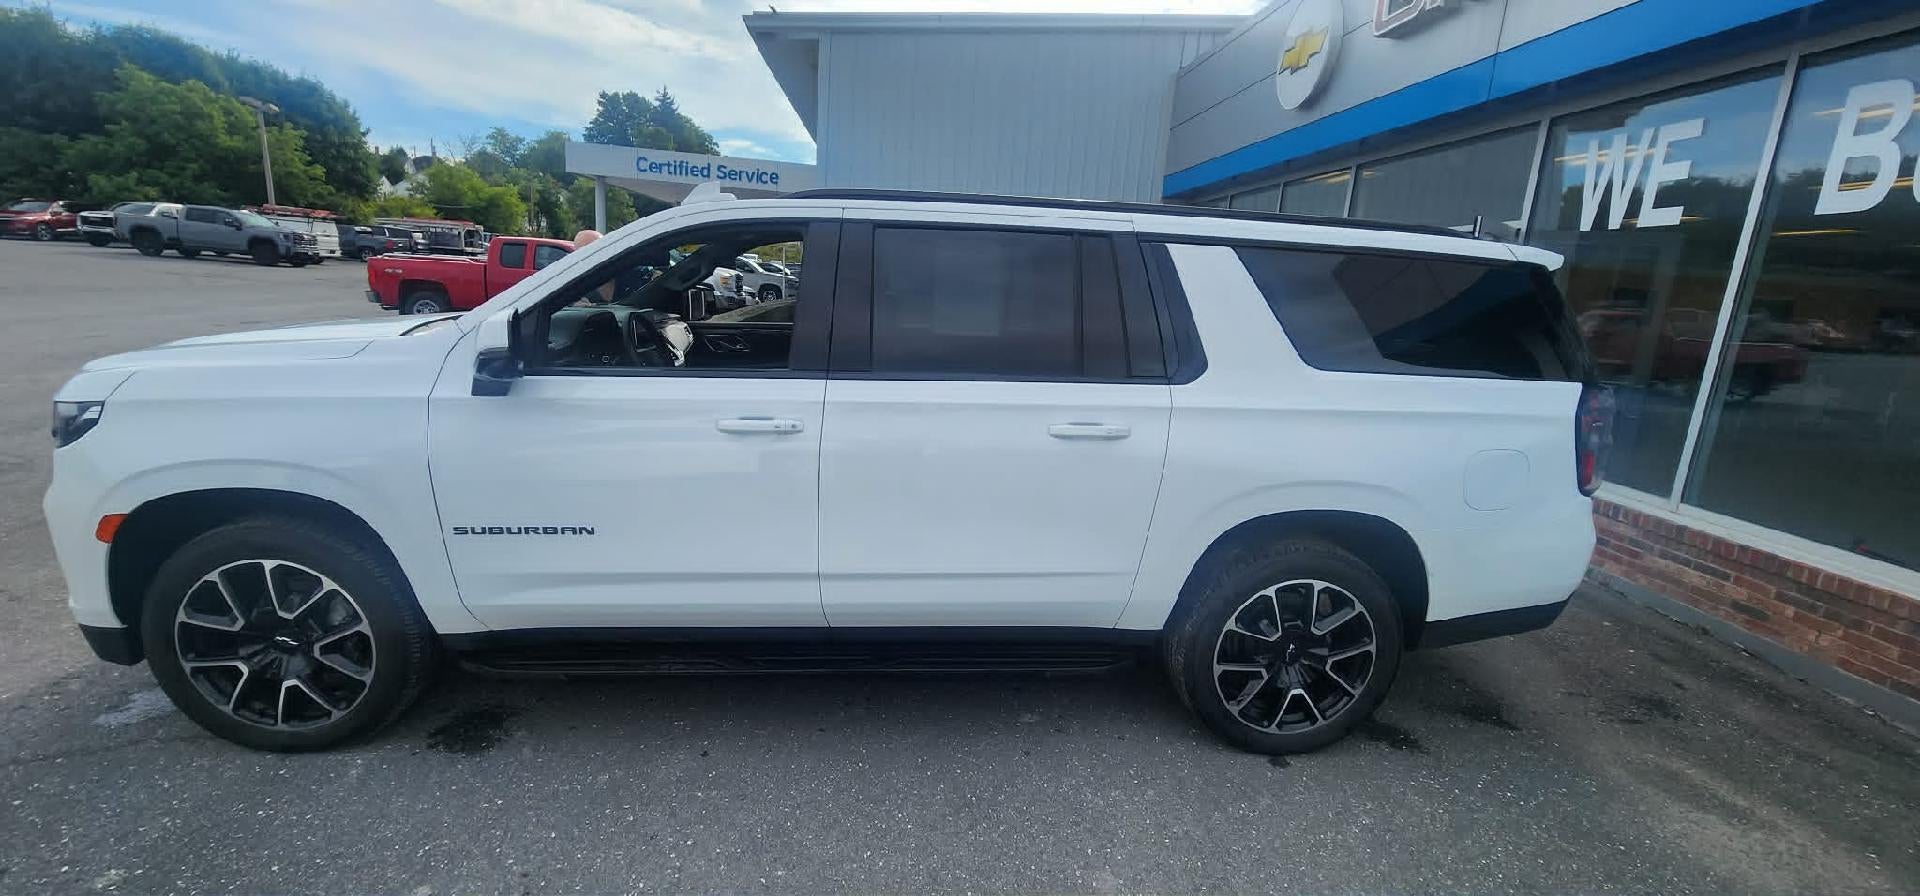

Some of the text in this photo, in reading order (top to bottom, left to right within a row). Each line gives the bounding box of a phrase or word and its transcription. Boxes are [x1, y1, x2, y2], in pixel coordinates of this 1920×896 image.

[1579, 78, 1920, 231] WE B
[636, 156, 780, 185] Certified Service
[452, 526, 595, 536] SUBURBAN
